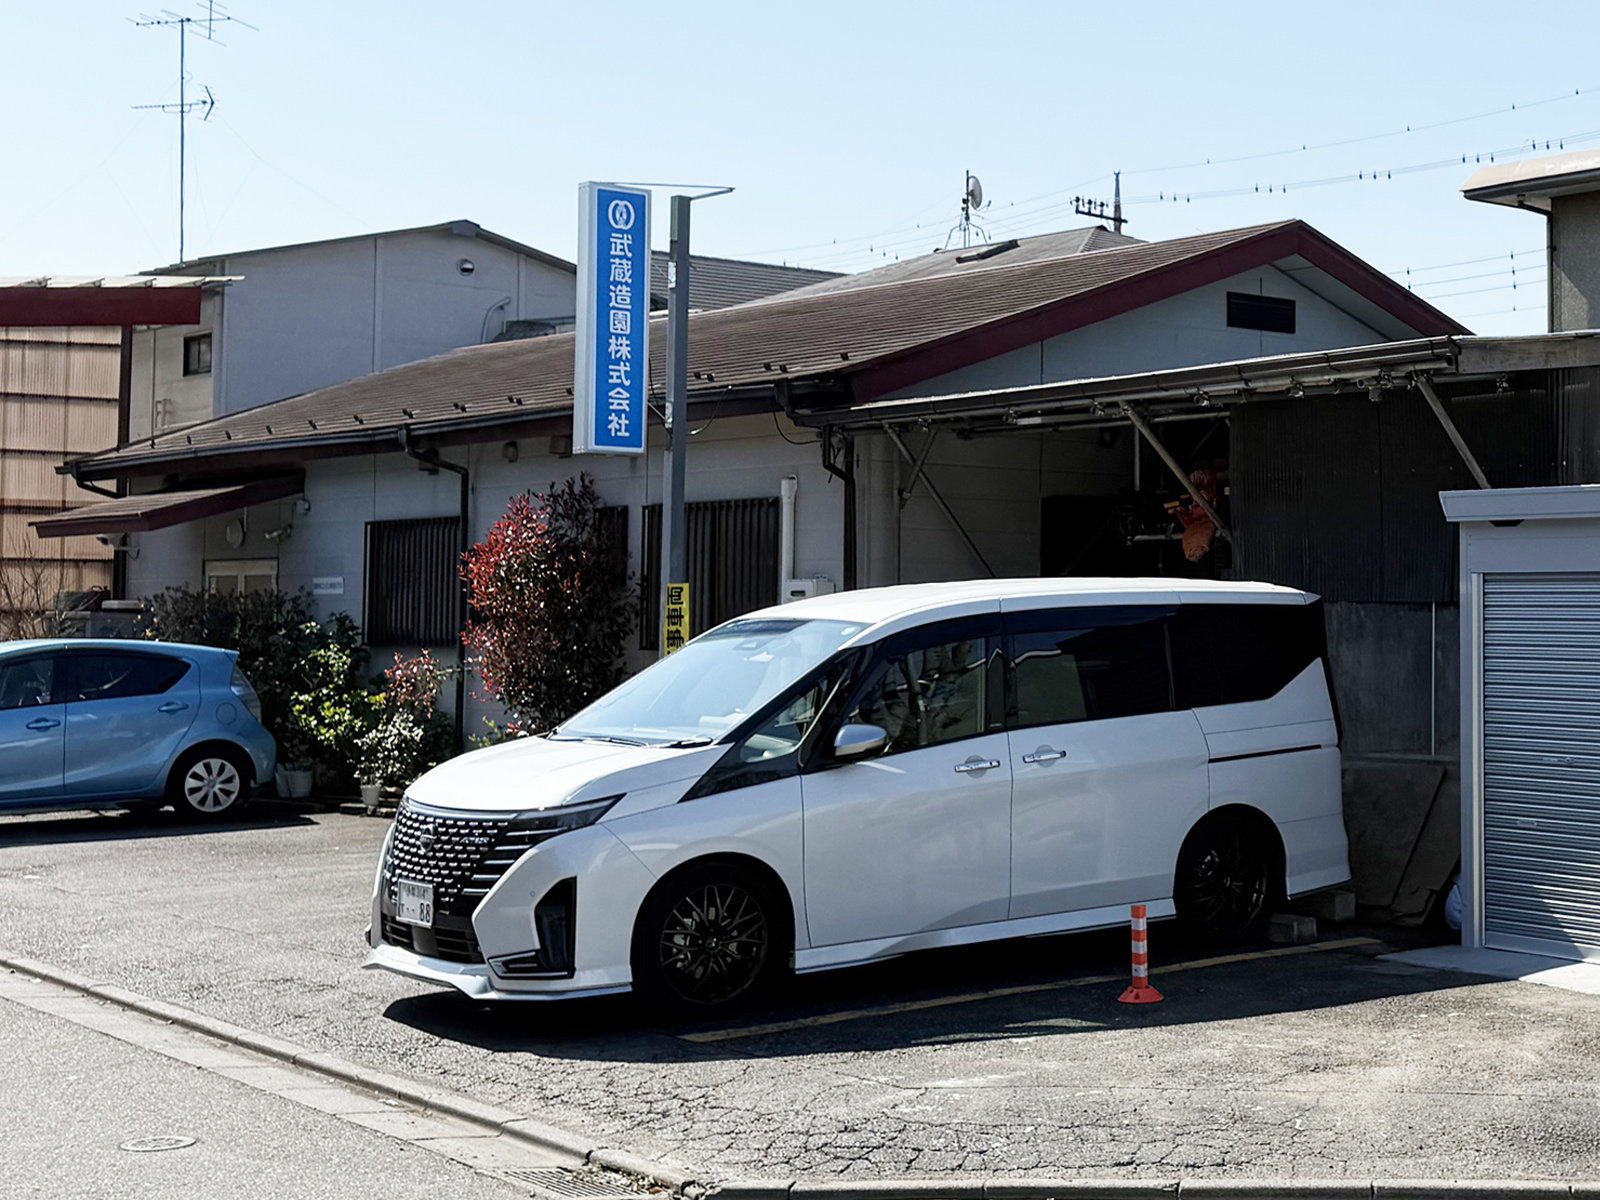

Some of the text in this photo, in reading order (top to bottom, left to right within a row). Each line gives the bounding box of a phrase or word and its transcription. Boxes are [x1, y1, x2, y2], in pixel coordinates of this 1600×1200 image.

[607, 232, 633, 438] 武蔵造園株式会社
[666, 586, 684, 654] 事車両
